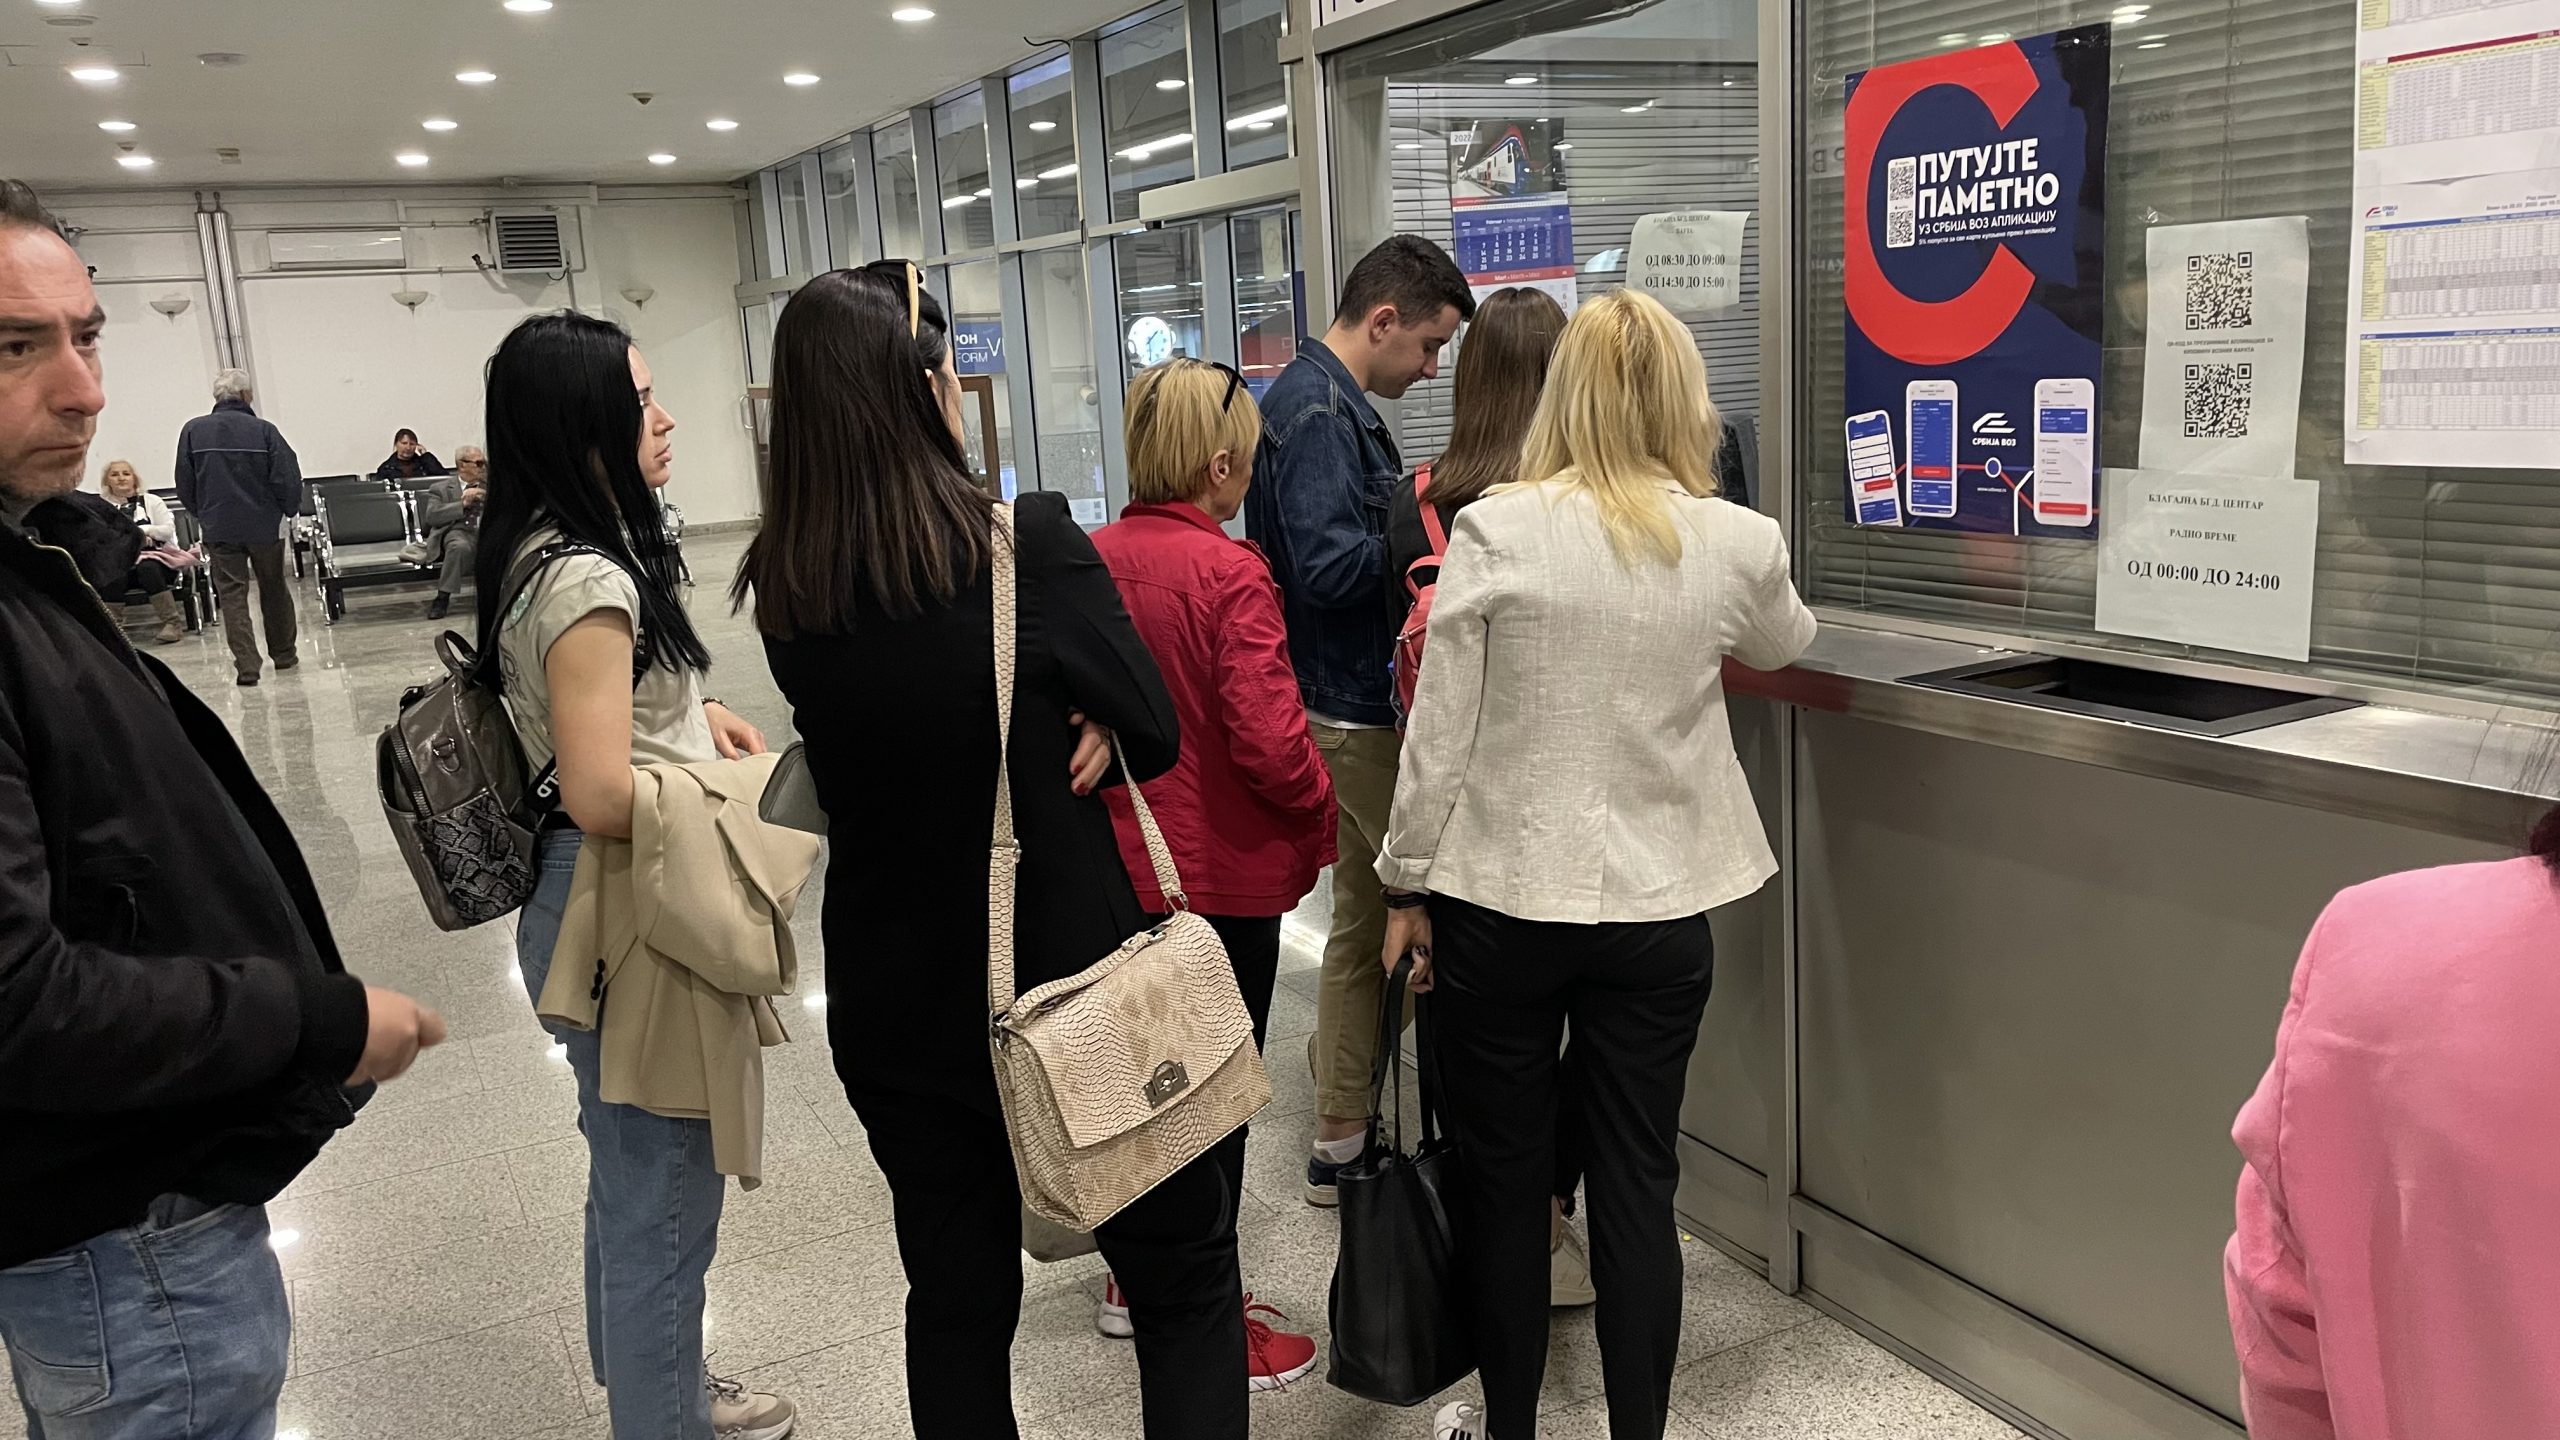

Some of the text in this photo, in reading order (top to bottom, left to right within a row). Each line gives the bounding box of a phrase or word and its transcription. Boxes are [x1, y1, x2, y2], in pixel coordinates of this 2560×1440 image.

[1920, 138, 2038, 185] ПУТУЈТЕ
[1919, 172, 2060, 219] ПАМЕТНО
[1919, 210, 2056, 234] УЗ СРБИЈА ВОЗ АПЛИКАЦИЈУ
[1646, 254, 1725, 267] ОД 08:30 ДО 09:00
[1646, 276, 1724, 288] ОД 14:30 ДО 15:00
[1972, 438, 2016, 447] СРБИЈА ВОЗ
[2149, 494, 2197, 506] БЛАГАЈНА
[2223, 499, 2264, 510] ЦЕНТАР
[2170, 528, 2237, 542] РАДНО ВРЕМЕ
[2128, 560, 2280, 591] ОД 00:00 ДО 24:00
